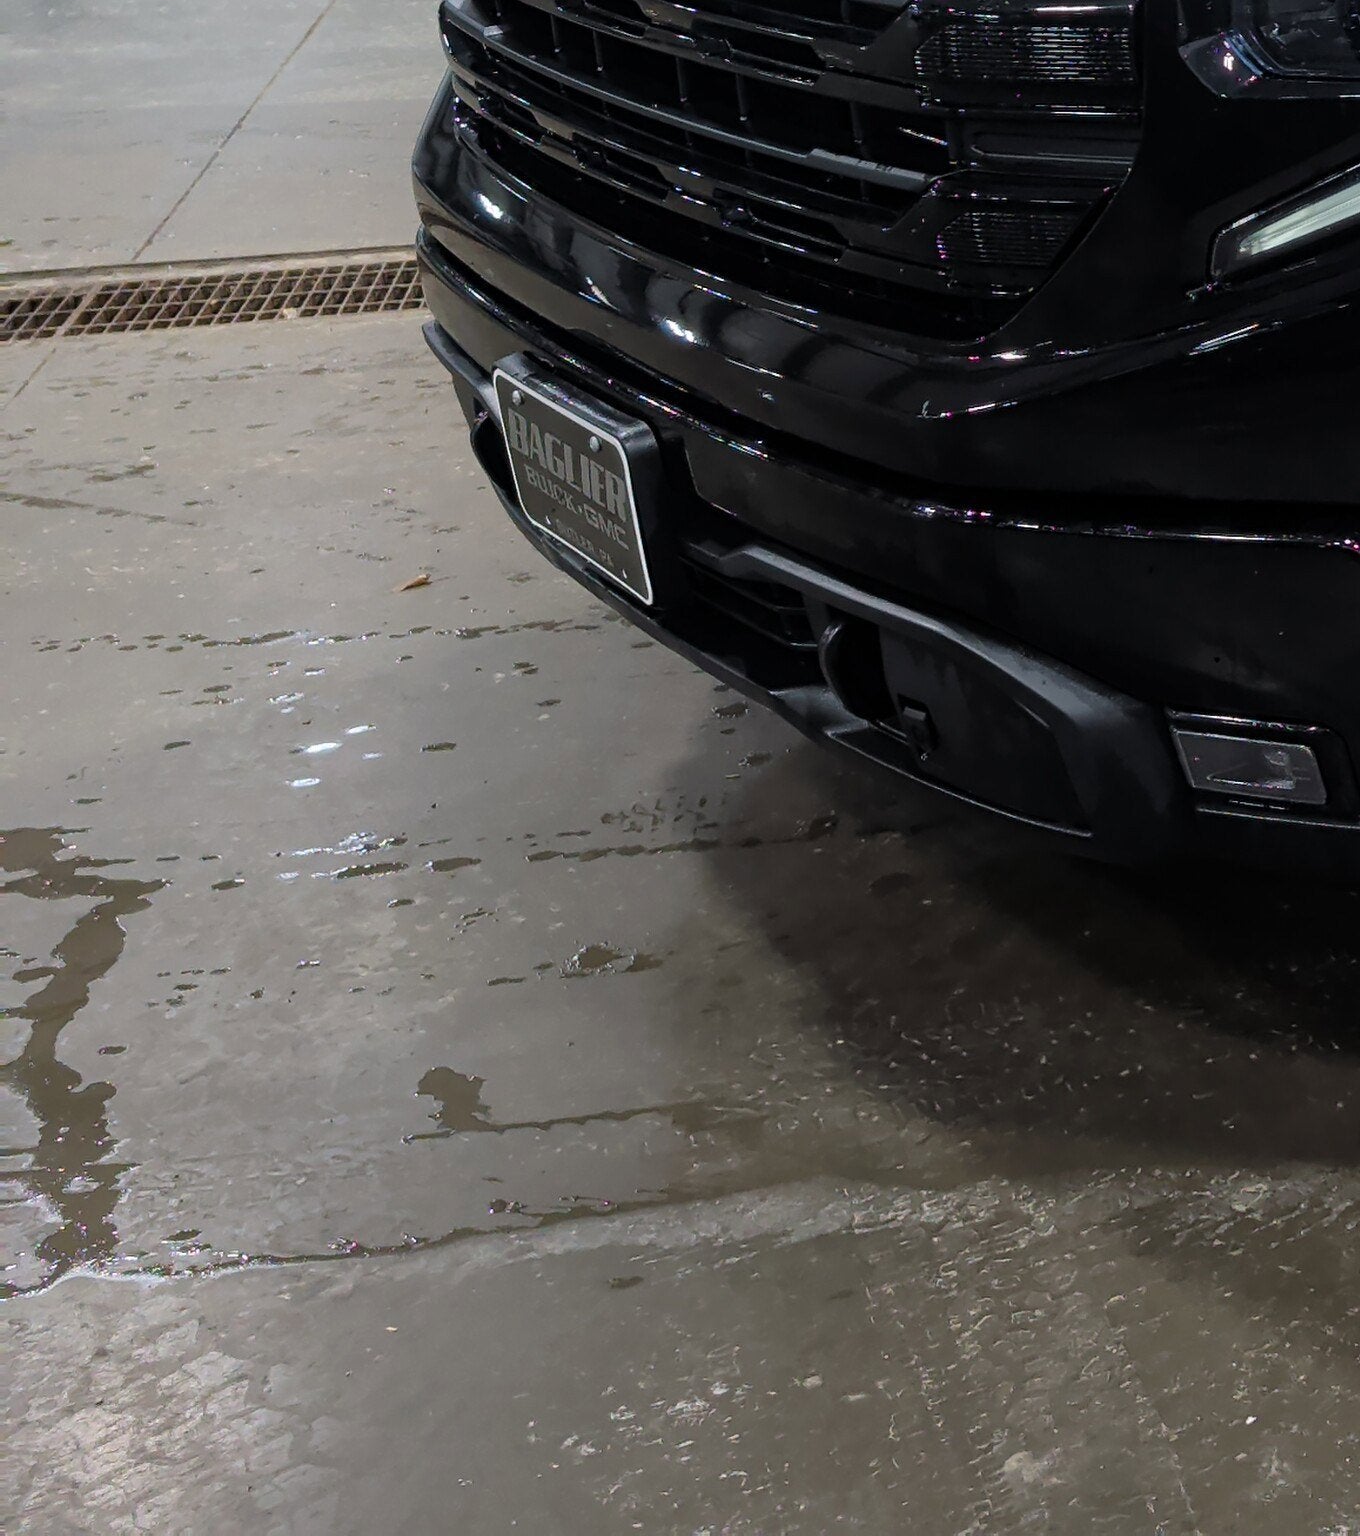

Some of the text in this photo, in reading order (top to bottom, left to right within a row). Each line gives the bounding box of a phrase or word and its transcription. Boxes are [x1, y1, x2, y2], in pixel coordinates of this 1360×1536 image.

[507, 407, 628, 523] BAGLIER
[524, 464, 629, 551] BUICK GMC
